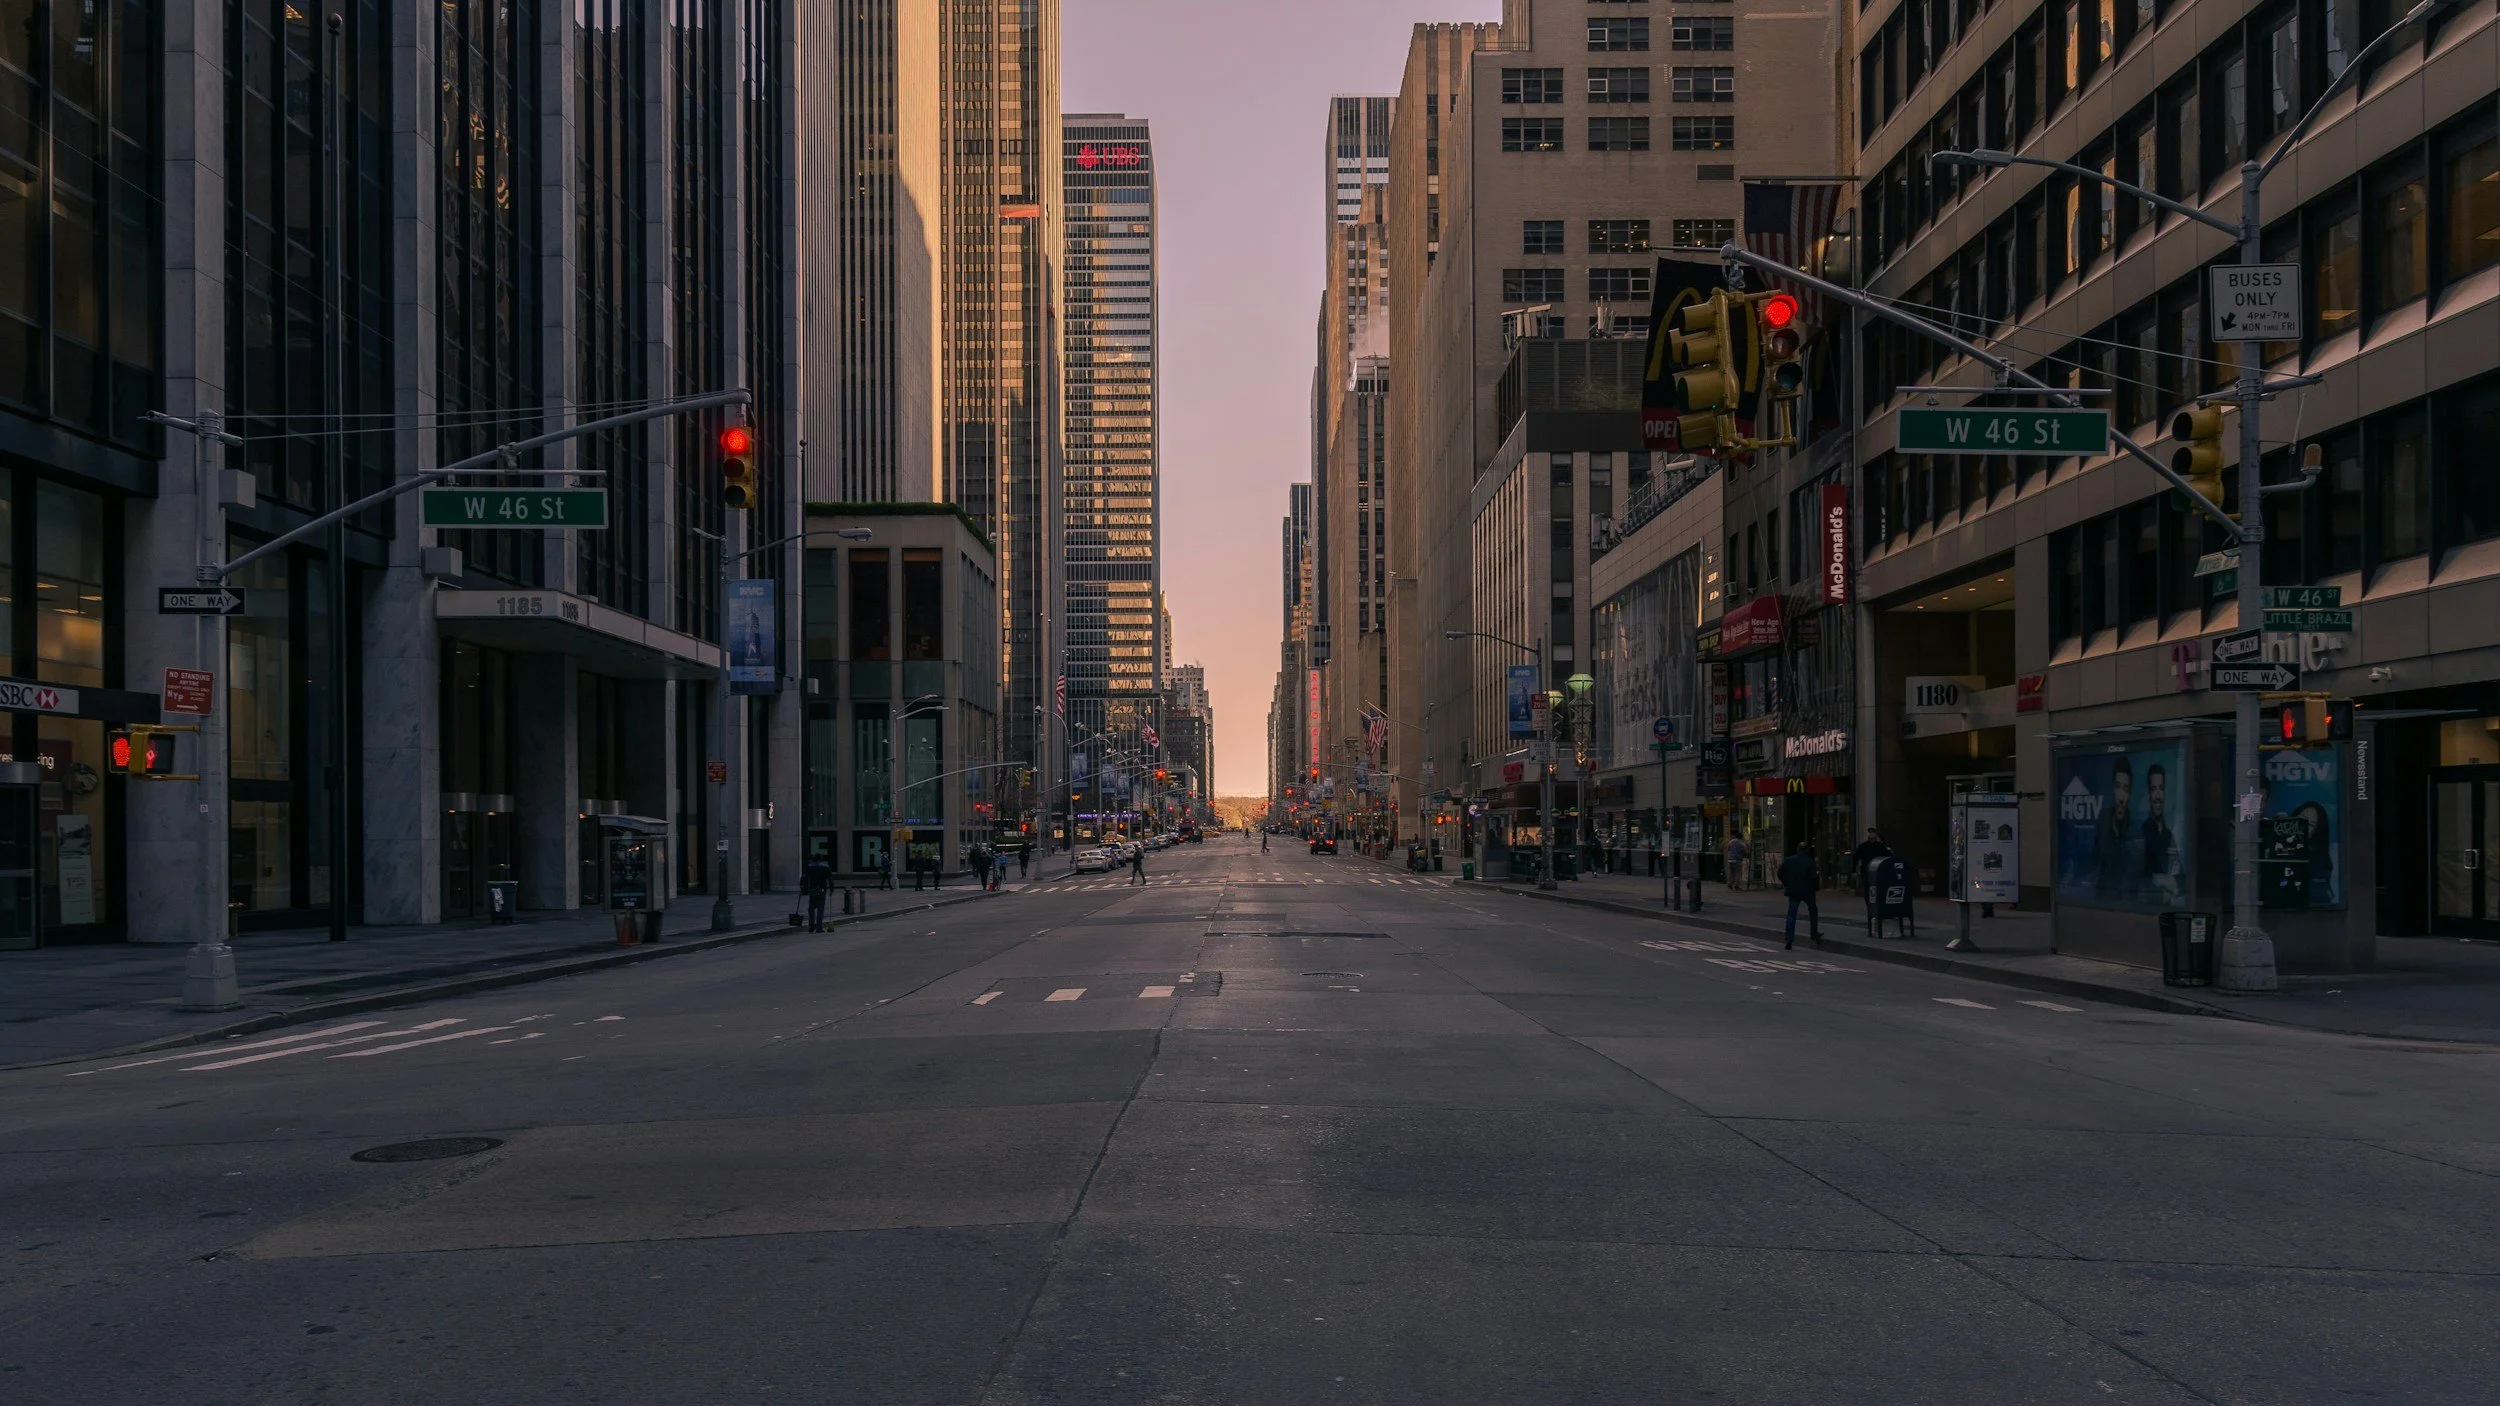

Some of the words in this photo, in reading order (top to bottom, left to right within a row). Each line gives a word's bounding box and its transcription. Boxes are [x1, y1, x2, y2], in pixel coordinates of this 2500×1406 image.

[1102, 147, 1139, 165] UBS
[2229, 272, 2282, 287] BUSES
[2235, 292, 2277, 307] ONLY
[2247, 311, 2290, 320] 4PM-7PM
[2242, 322, 2260, 331] MON
[2281, 322, 2295, 331] FRI
[1644, 419, 1677, 439] OPE
[1945, 417, 1971, 443] W
[1985, 418, 2020, 444] 46
[2033, 418, 2061, 445] St
[464, 496, 486, 519] W
[498, 497, 528, 520] 46
[541, 497, 564, 520] St
[1829, 505, 1844, 600] McDonald's
[170, 596, 196, 607] ONE
[206, 596, 232, 607] WAY
[497, 597, 543, 615] 1185
[2277, 588, 2291, 607] W
[2299, 588, 2322, 606] 46
[2326, 589, 2338, 599] ST
[2264, 611, 2303, 625] LITTLE
[2307, 612, 2352, 625] BRAZIL
[2219, 643, 2233, 656] ONE
[2239, 638, 2257, 650] WAY
[169, 671, 179, 679] NO
[180, 672, 211, 681] STANDING
[2223, 671, 2249, 683] ONE
[2260, 671, 2287, 683] WAY
[167, 689, 184, 702] NYP
[1714, 694, 1727, 706] BUY
[1916, 684, 1958, 707] 1180
[1784, 729, 1847, 758] McDonald's
[1704, 749, 1724, 763] Big
[2265, 762, 2332, 781] HGTV
[2356, 739, 2369, 801] Newsstand
[2061, 795, 2104, 820] HGTV
